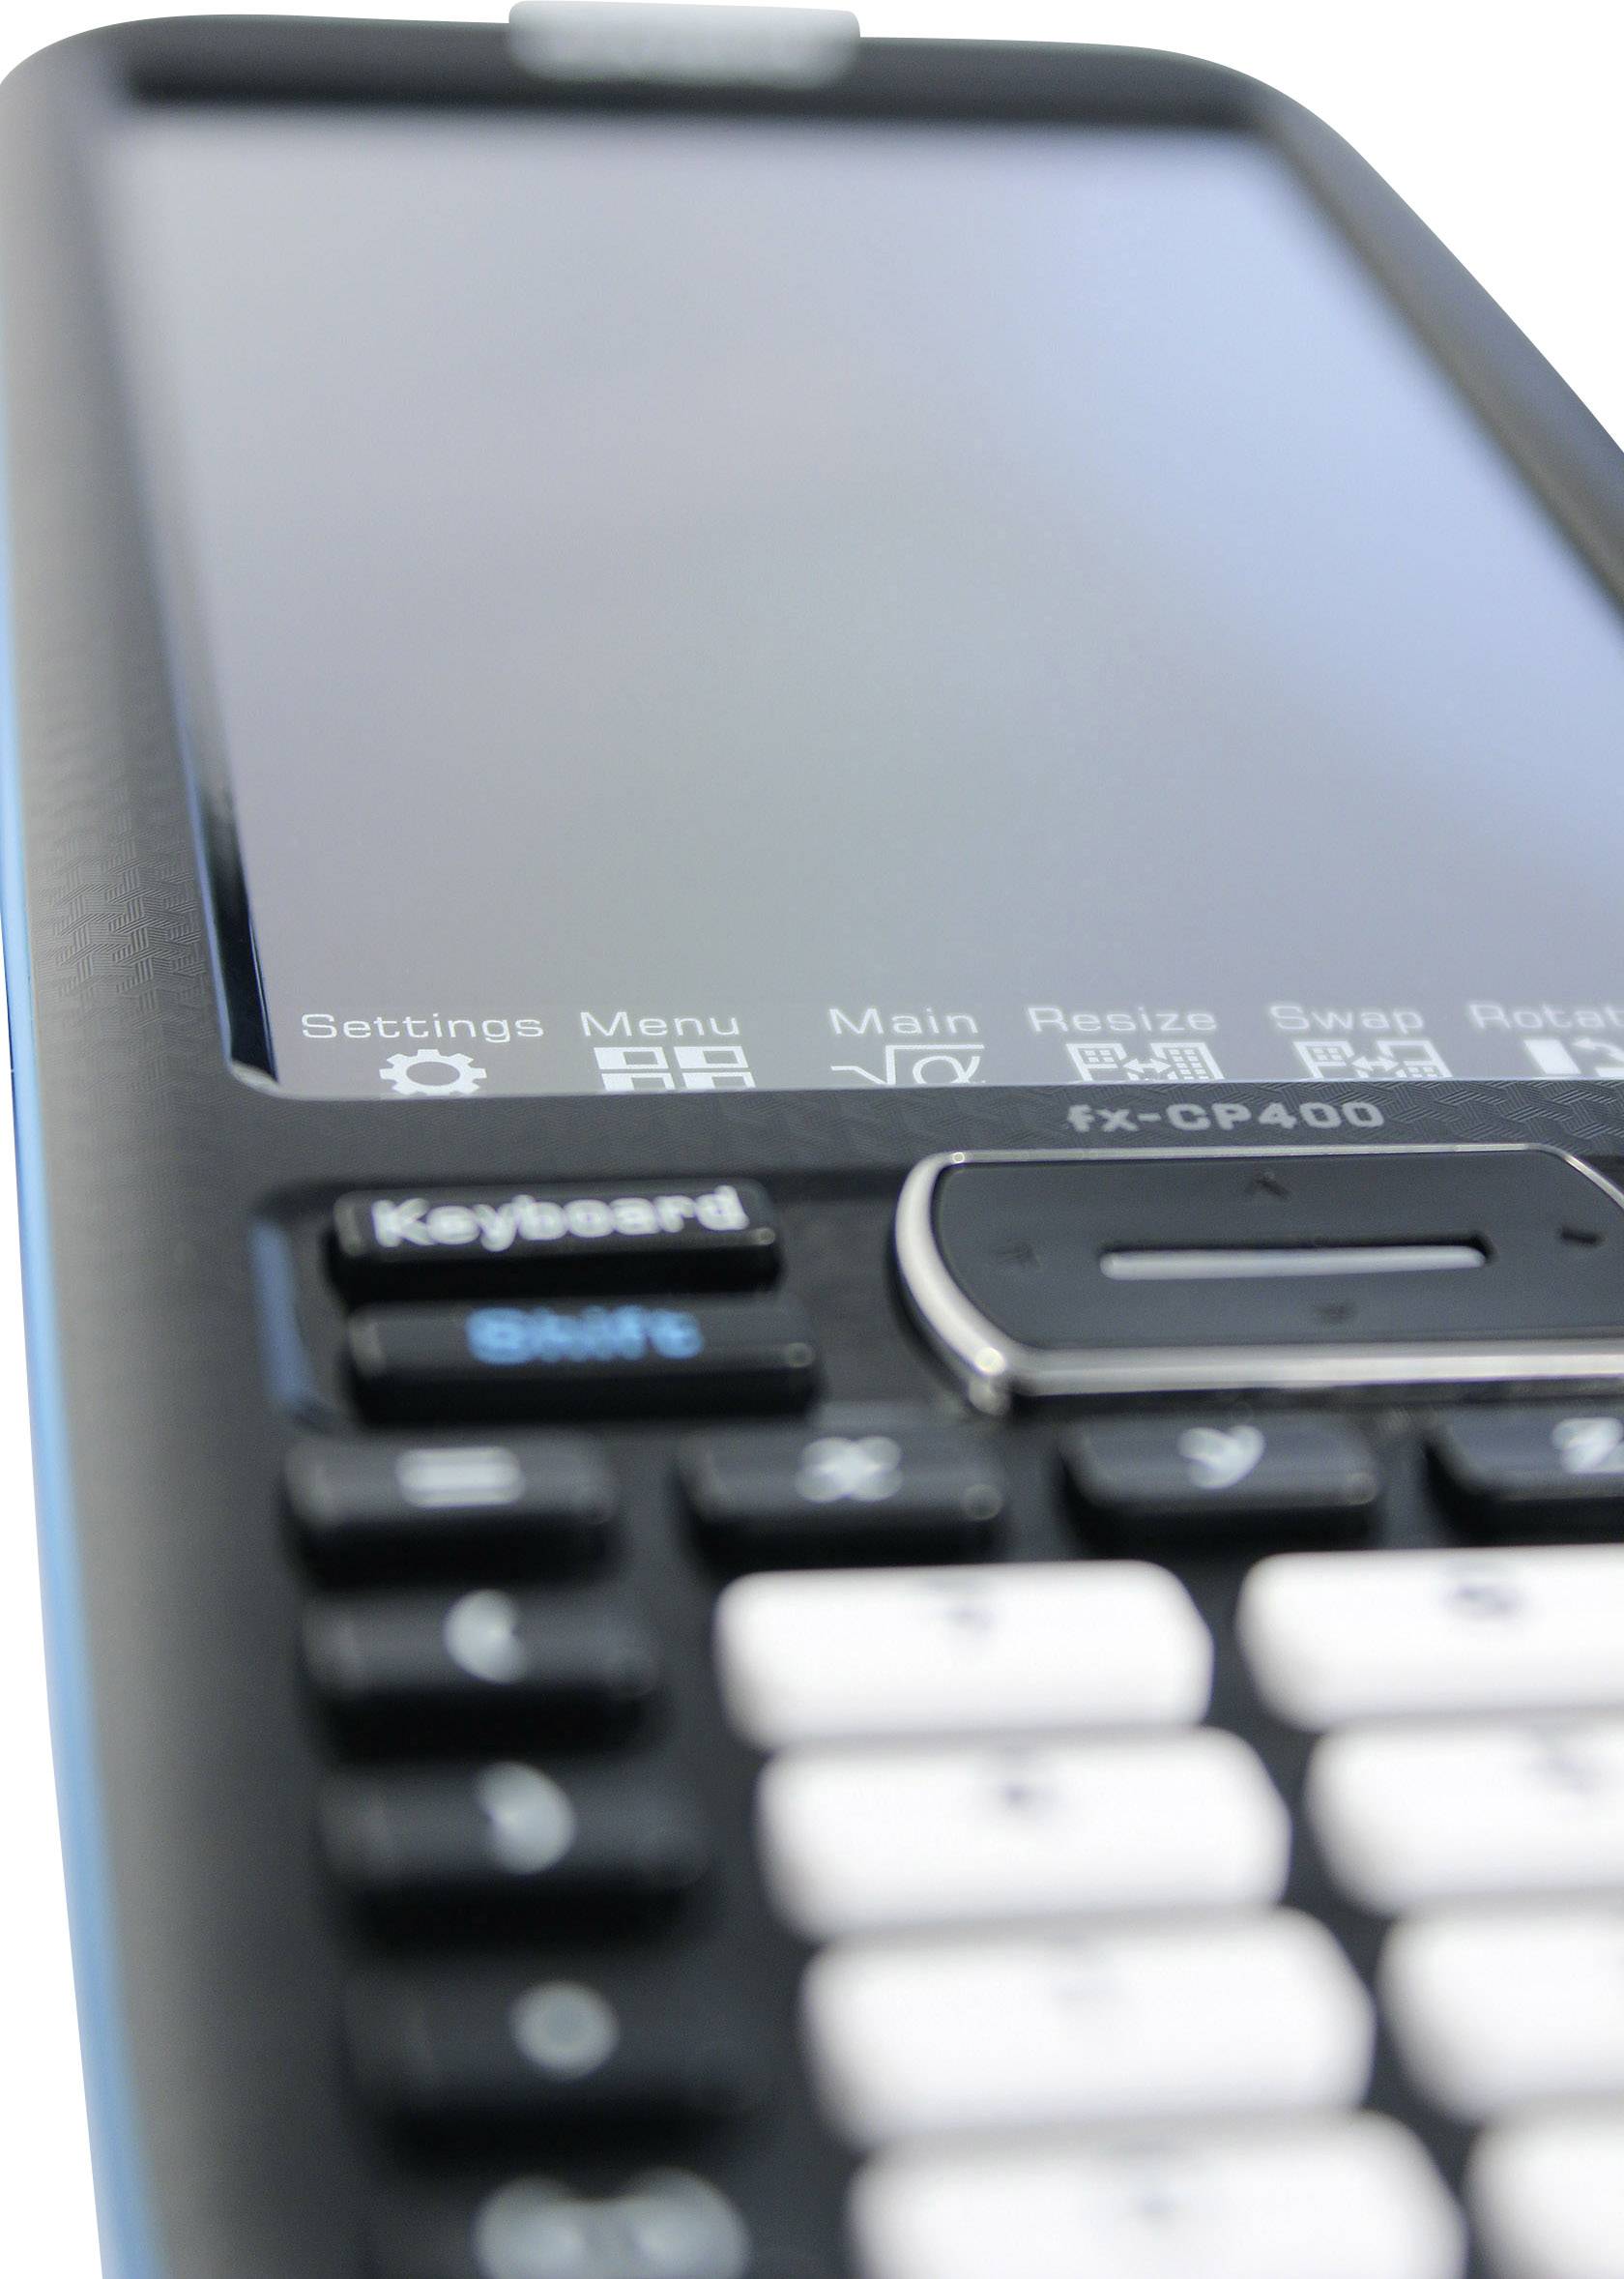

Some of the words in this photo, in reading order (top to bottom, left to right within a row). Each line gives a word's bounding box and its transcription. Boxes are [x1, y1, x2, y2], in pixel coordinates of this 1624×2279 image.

[301, 1013, 544, 1043] Settings
[579, 1011, 740, 1037] Menu
[828, 1007, 979, 1036] Main
[1028, 1005, 1218, 1034] Resize
[1269, 1004, 1426, 1035] Swap
[1066, 1102, 1384, 1133] fx-CP400
[372, 1184, 750, 1251] Keyboard
